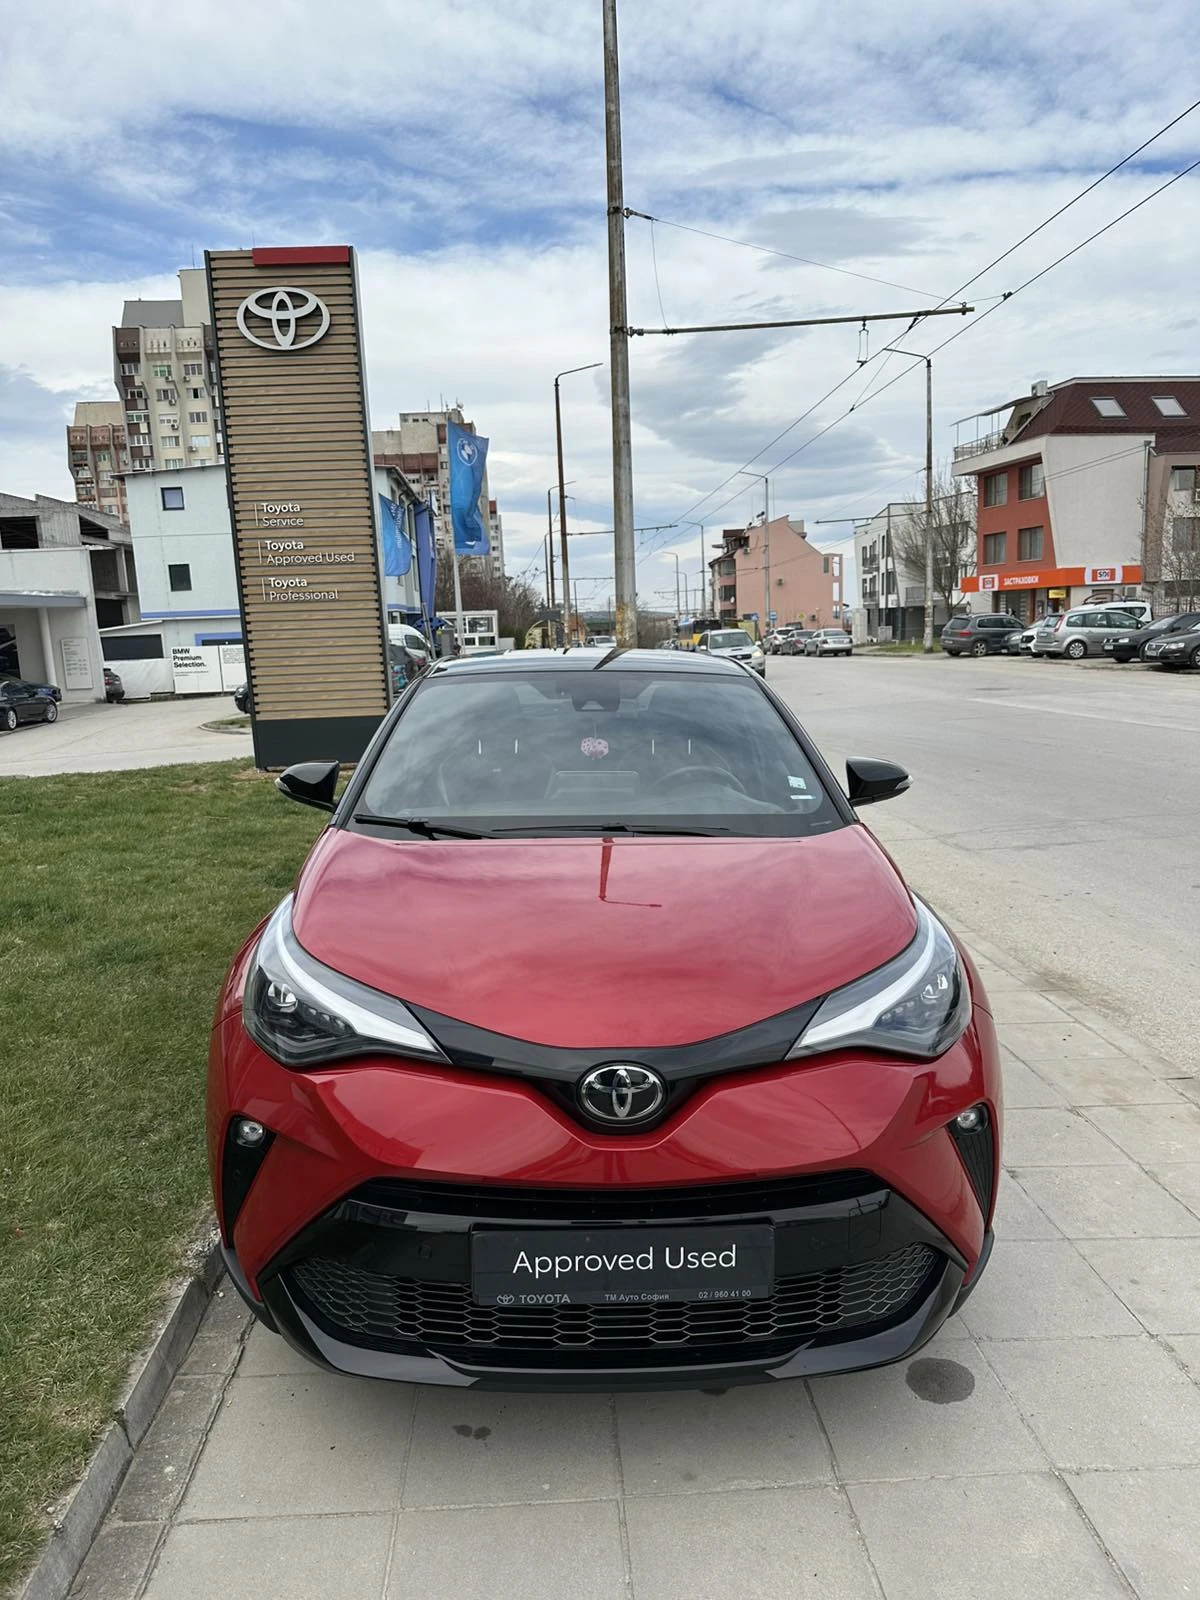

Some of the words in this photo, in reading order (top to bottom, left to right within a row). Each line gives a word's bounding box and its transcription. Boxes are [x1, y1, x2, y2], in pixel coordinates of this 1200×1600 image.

[261, 503, 301, 515] Toyota
[262, 516, 304, 527] Service
[265, 540, 304, 552] Toyota
[266, 552, 323, 566] Approved
[325, 551, 355, 562] Used
[268, 577, 308, 589] Toyota
[269, 589, 339, 601] Professional
[174, 661, 207, 669] Selection.
[512, 1246, 654, 1279] Approved
[664, 1243, 737, 1269] Used
[519, 1293, 571, 1304] TOYOTA
[619, 1293, 639, 1302] Ауто
[641, 1293, 670, 1301] София
[698, 1291, 709, 1299] 02
[730, 1289, 739, 1297] 41
[741, 1289, 752, 1297] 00
